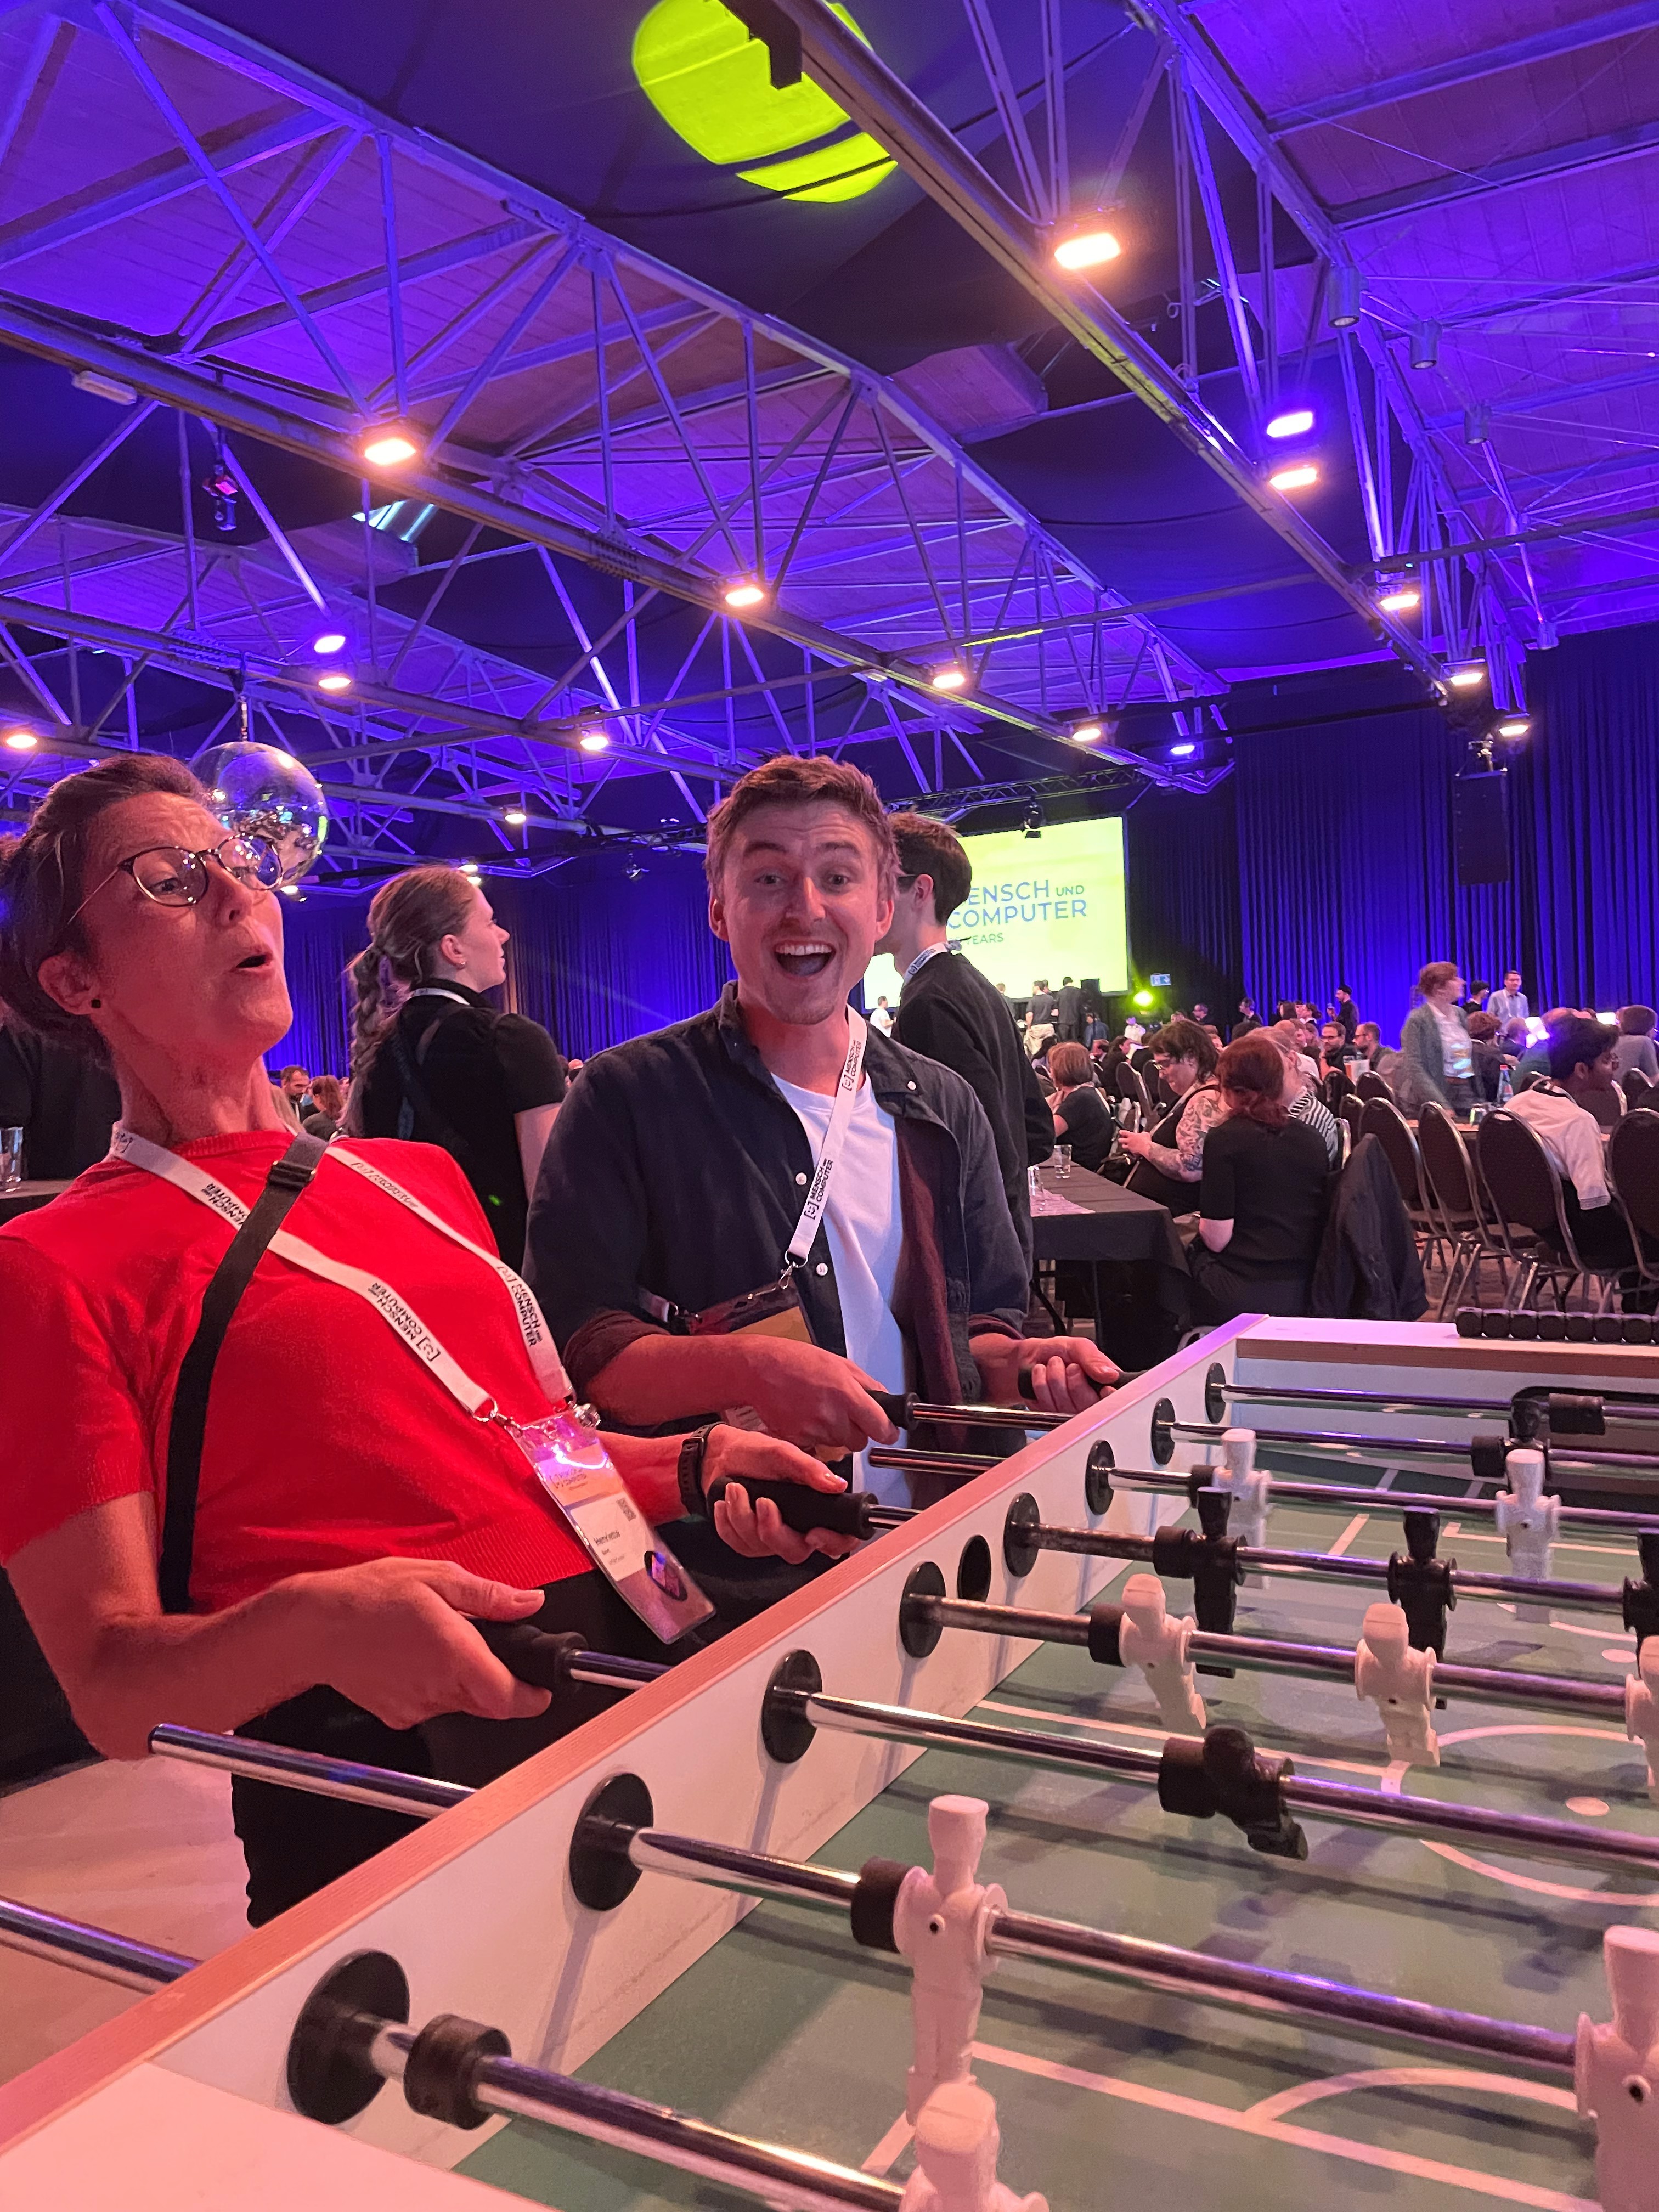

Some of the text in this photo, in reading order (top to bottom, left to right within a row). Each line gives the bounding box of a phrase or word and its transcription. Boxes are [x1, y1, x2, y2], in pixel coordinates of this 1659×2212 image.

[968, 879, 1085, 906] ENSCH UND
[947, 899, 1087, 929] COMPUTER
[810, 1166, 825, 1200] MENSCH
[816, 1159, 833, 1202] COMPUTER
[371, 1282, 422, 1335] COMPUTER
[377, 1298, 416, 1340] MENSCH
[511, 1285, 537, 1347] COMPUTER
[516, 1284, 541, 1328] MENSCH
